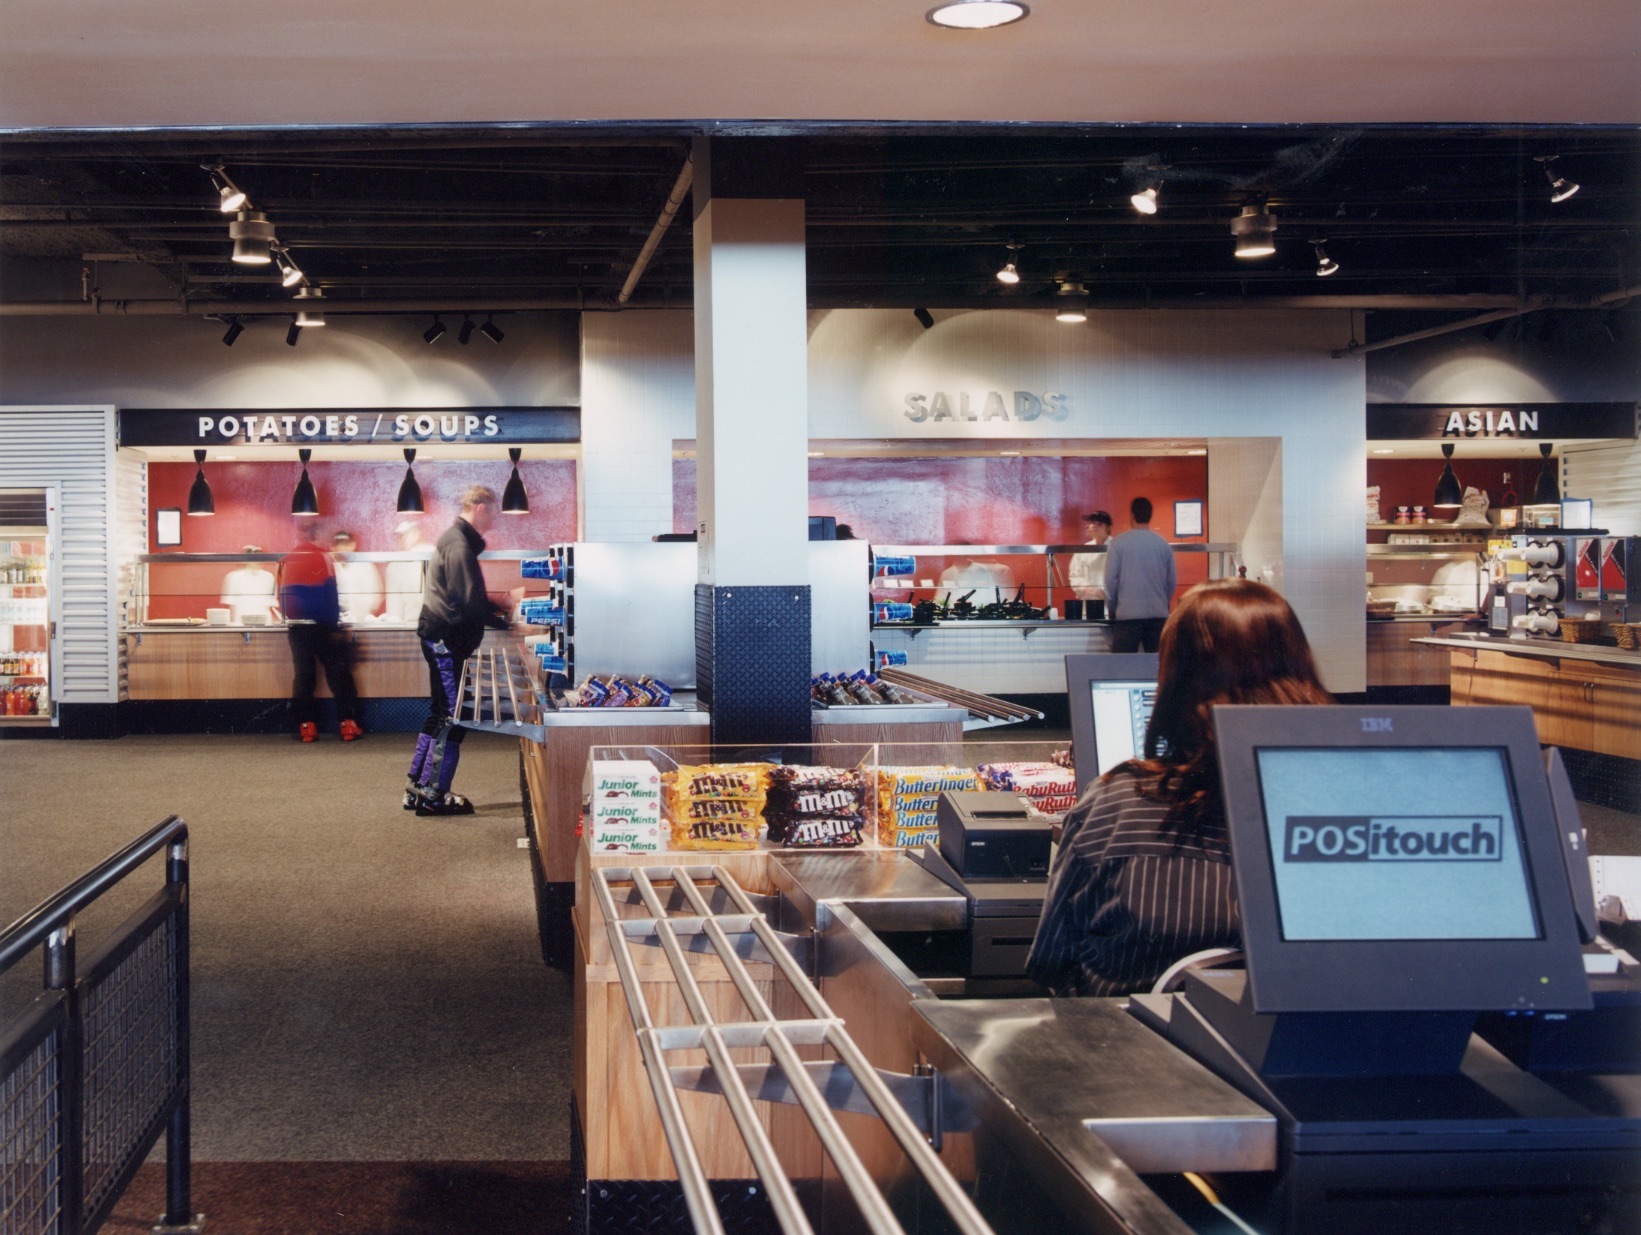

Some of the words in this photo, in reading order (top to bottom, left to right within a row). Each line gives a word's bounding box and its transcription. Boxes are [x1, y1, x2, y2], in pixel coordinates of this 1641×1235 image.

[904, 391, 1066, 420] SALADS
[198, 415, 359, 438] POTATOES
[371, 413, 384, 438] /
[395, 415, 499, 437] SOUPS
[1446, 410, 1539, 432] ASIAN
[530, 617, 561, 625] PEPSI
[1361, 718, 1393, 732] IBM
[597, 779, 640, 790] Junior
[894, 777, 978, 795] Butterfinger
[630, 789, 658, 798] Mints
[597, 806, 639, 817] Junior
[630, 816, 657, 825] Mints
[597, 832, 639, 843] Junior
[1290, 823, 1496, 857] POSitouch
[630, 842, 657, 851] Mints
